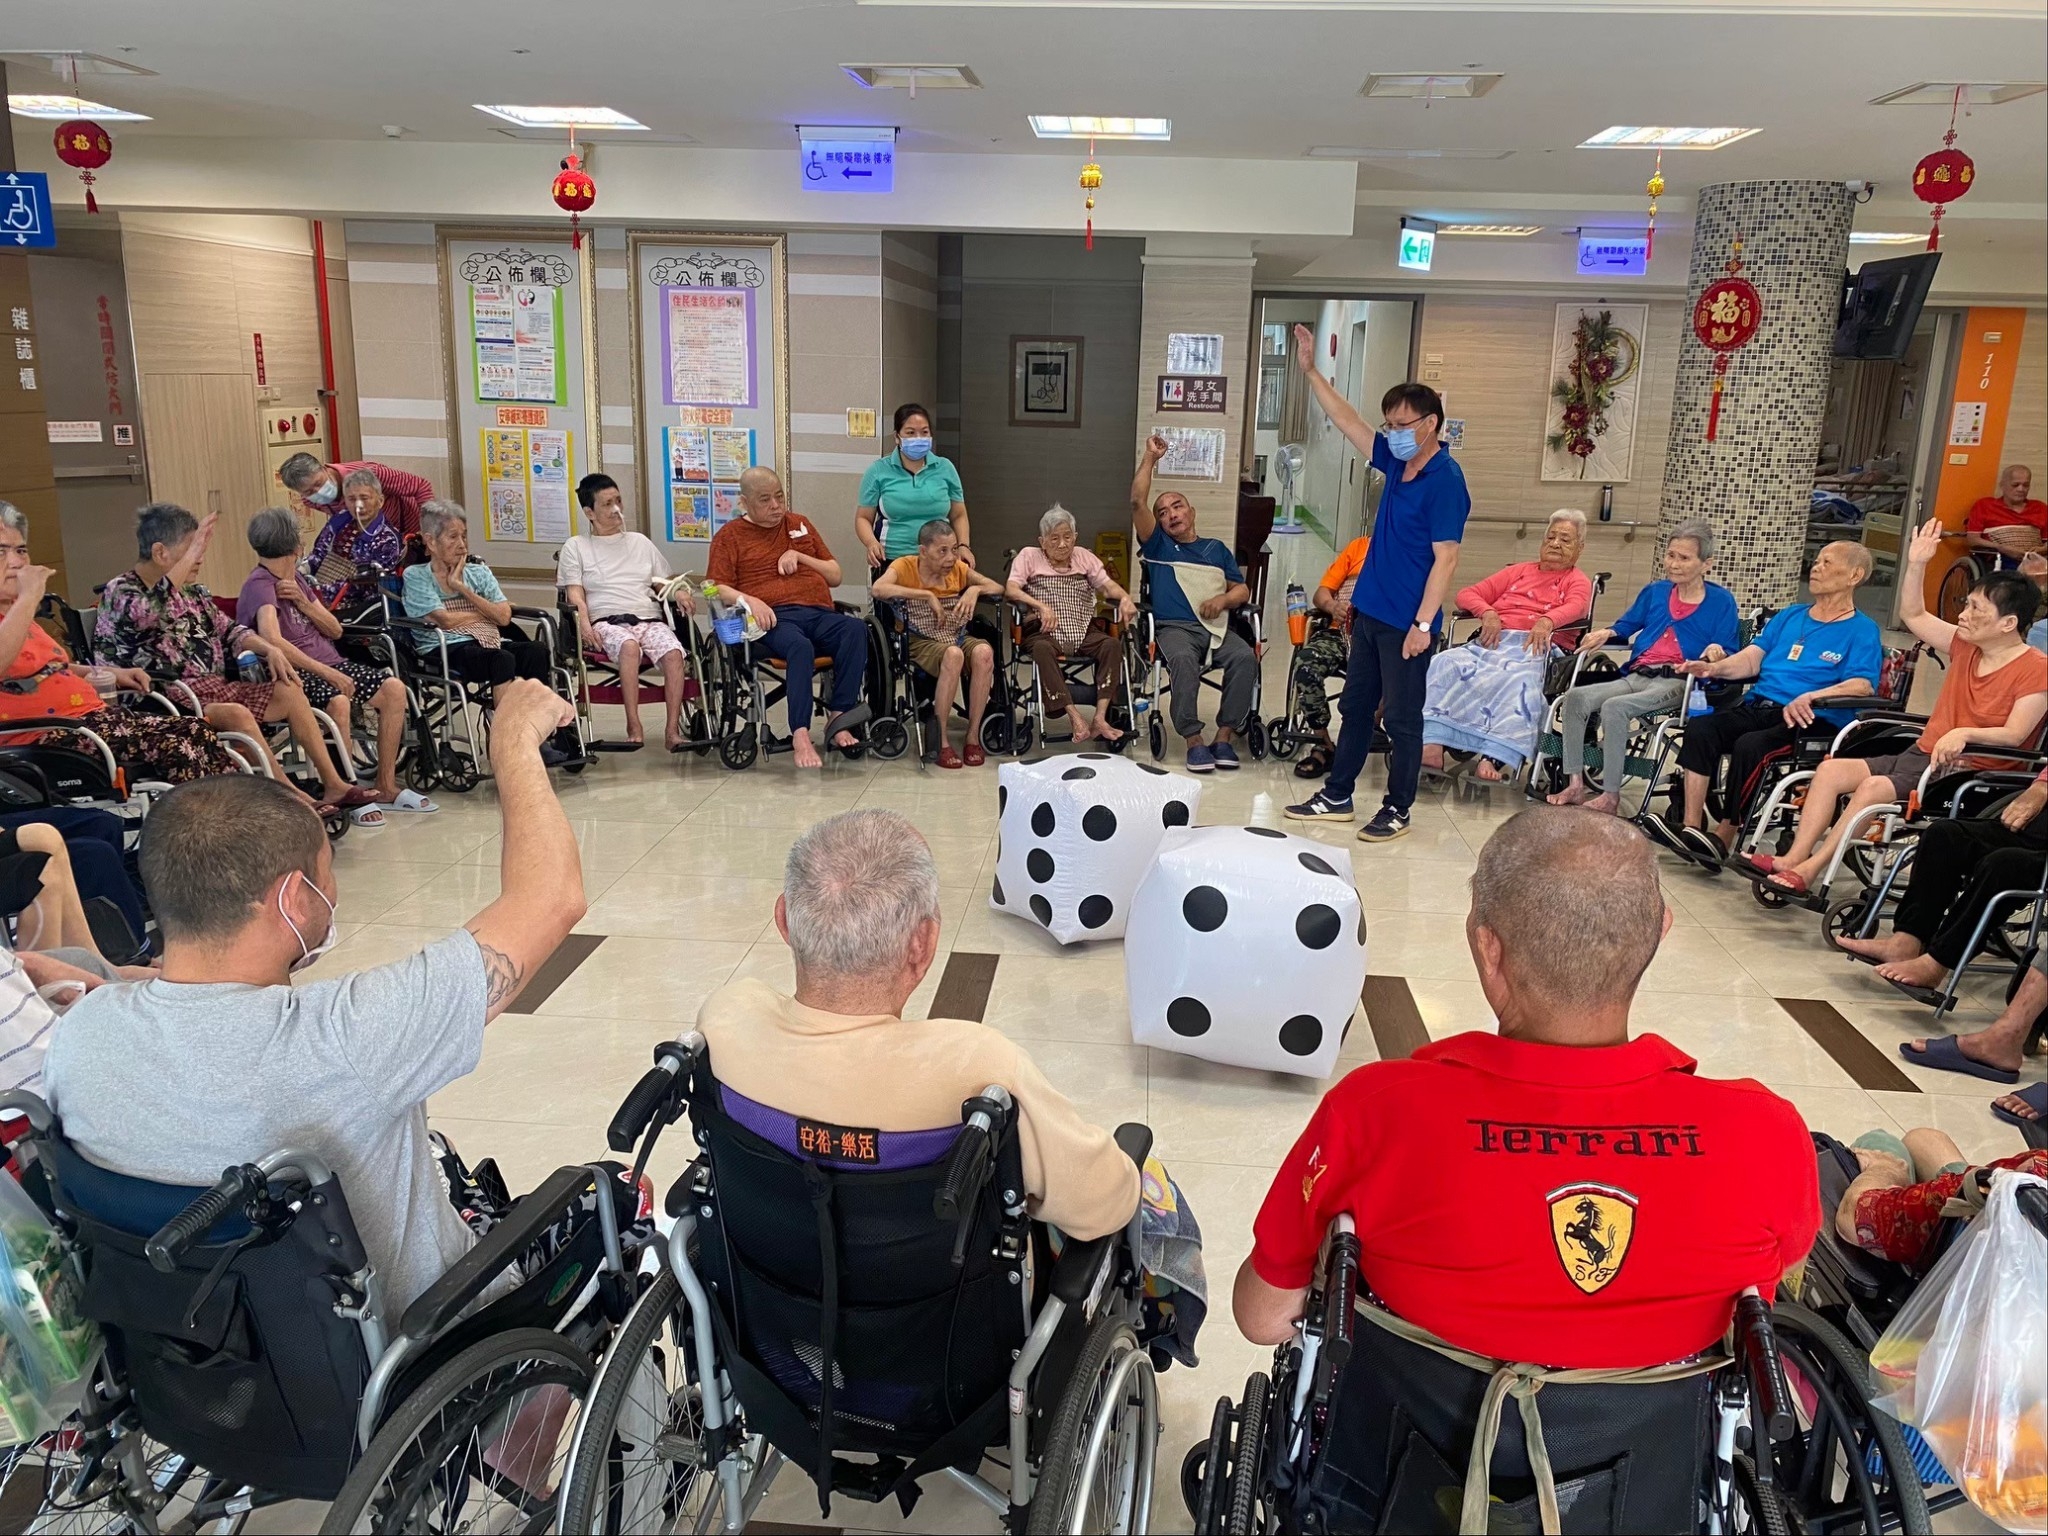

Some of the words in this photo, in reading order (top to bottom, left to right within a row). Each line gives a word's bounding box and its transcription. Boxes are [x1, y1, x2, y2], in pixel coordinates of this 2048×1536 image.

[486, 265, 546, 284] 公佈欄
[676, 270, 737, 287] 公佈欄
[1711, 291, 1740, 323] 福
[11, 306, 37, 390] 雜誌櫃
[1979, 352, 1995, 390] 110
[1193, 379, 1217, 391] 男女
[1186, 391, 1223, 402] 洗手間
[1188, 402, 1220, 410] Restroom
[117, 426, 131, 439] 推
[1466, 1118, 1705, 1157] Ferrari
